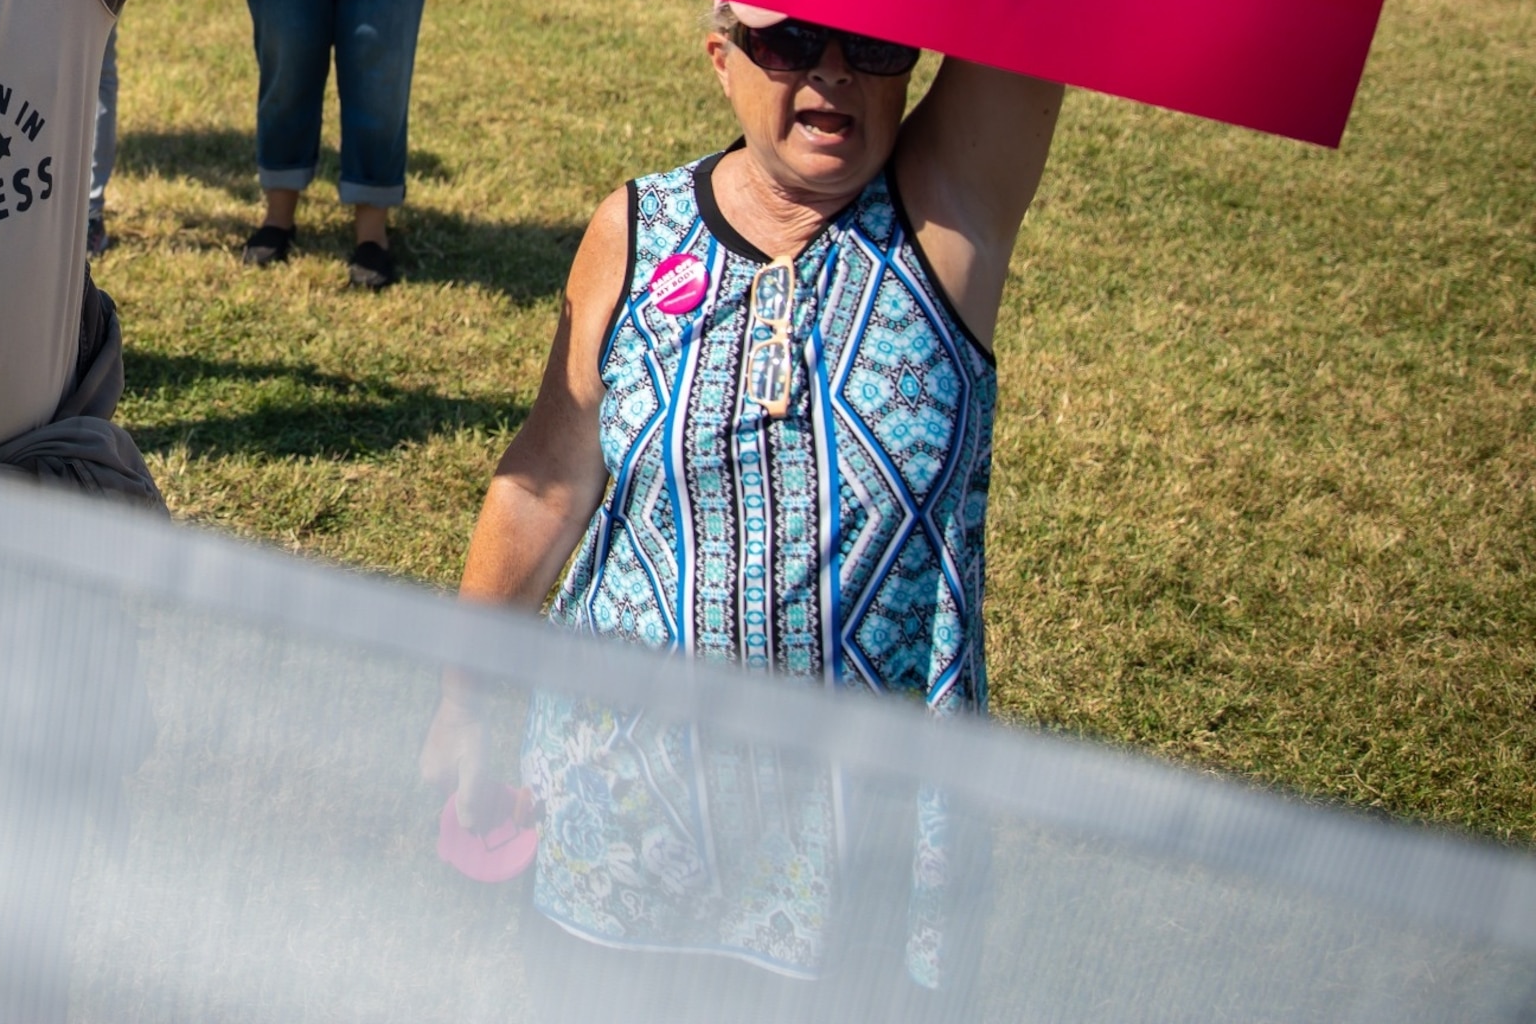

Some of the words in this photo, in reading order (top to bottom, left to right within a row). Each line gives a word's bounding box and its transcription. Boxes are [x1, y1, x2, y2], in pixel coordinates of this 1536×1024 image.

[15, 100, 45, 142] IN
[657, 286, 669, 297] MY
[672, 270, 694, 287] BODY
